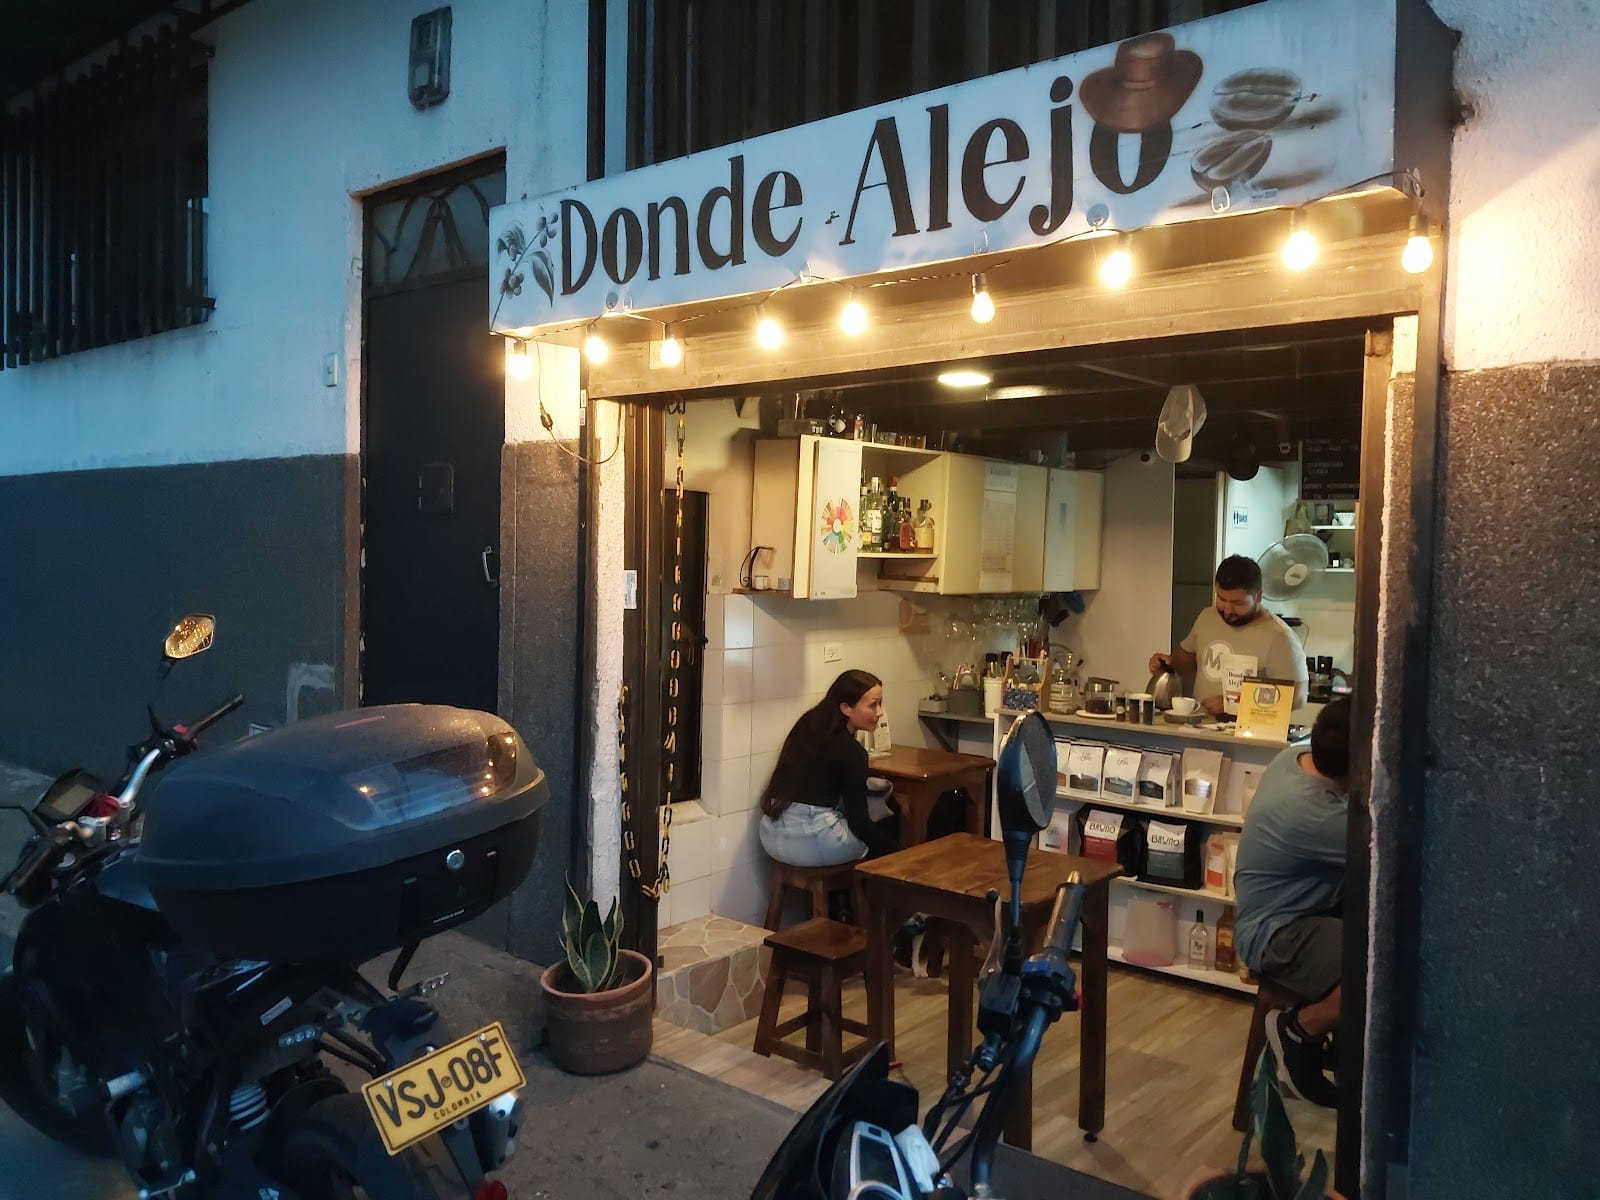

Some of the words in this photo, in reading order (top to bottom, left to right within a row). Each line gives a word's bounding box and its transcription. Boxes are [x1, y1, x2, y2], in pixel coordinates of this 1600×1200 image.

[560, 154, 803, 295] Donde
[839, 76, 1172, 245] Alejo
[1203, 647, 1223, 671] M
[434, 1091, 482, 1120] COLOMBIA
